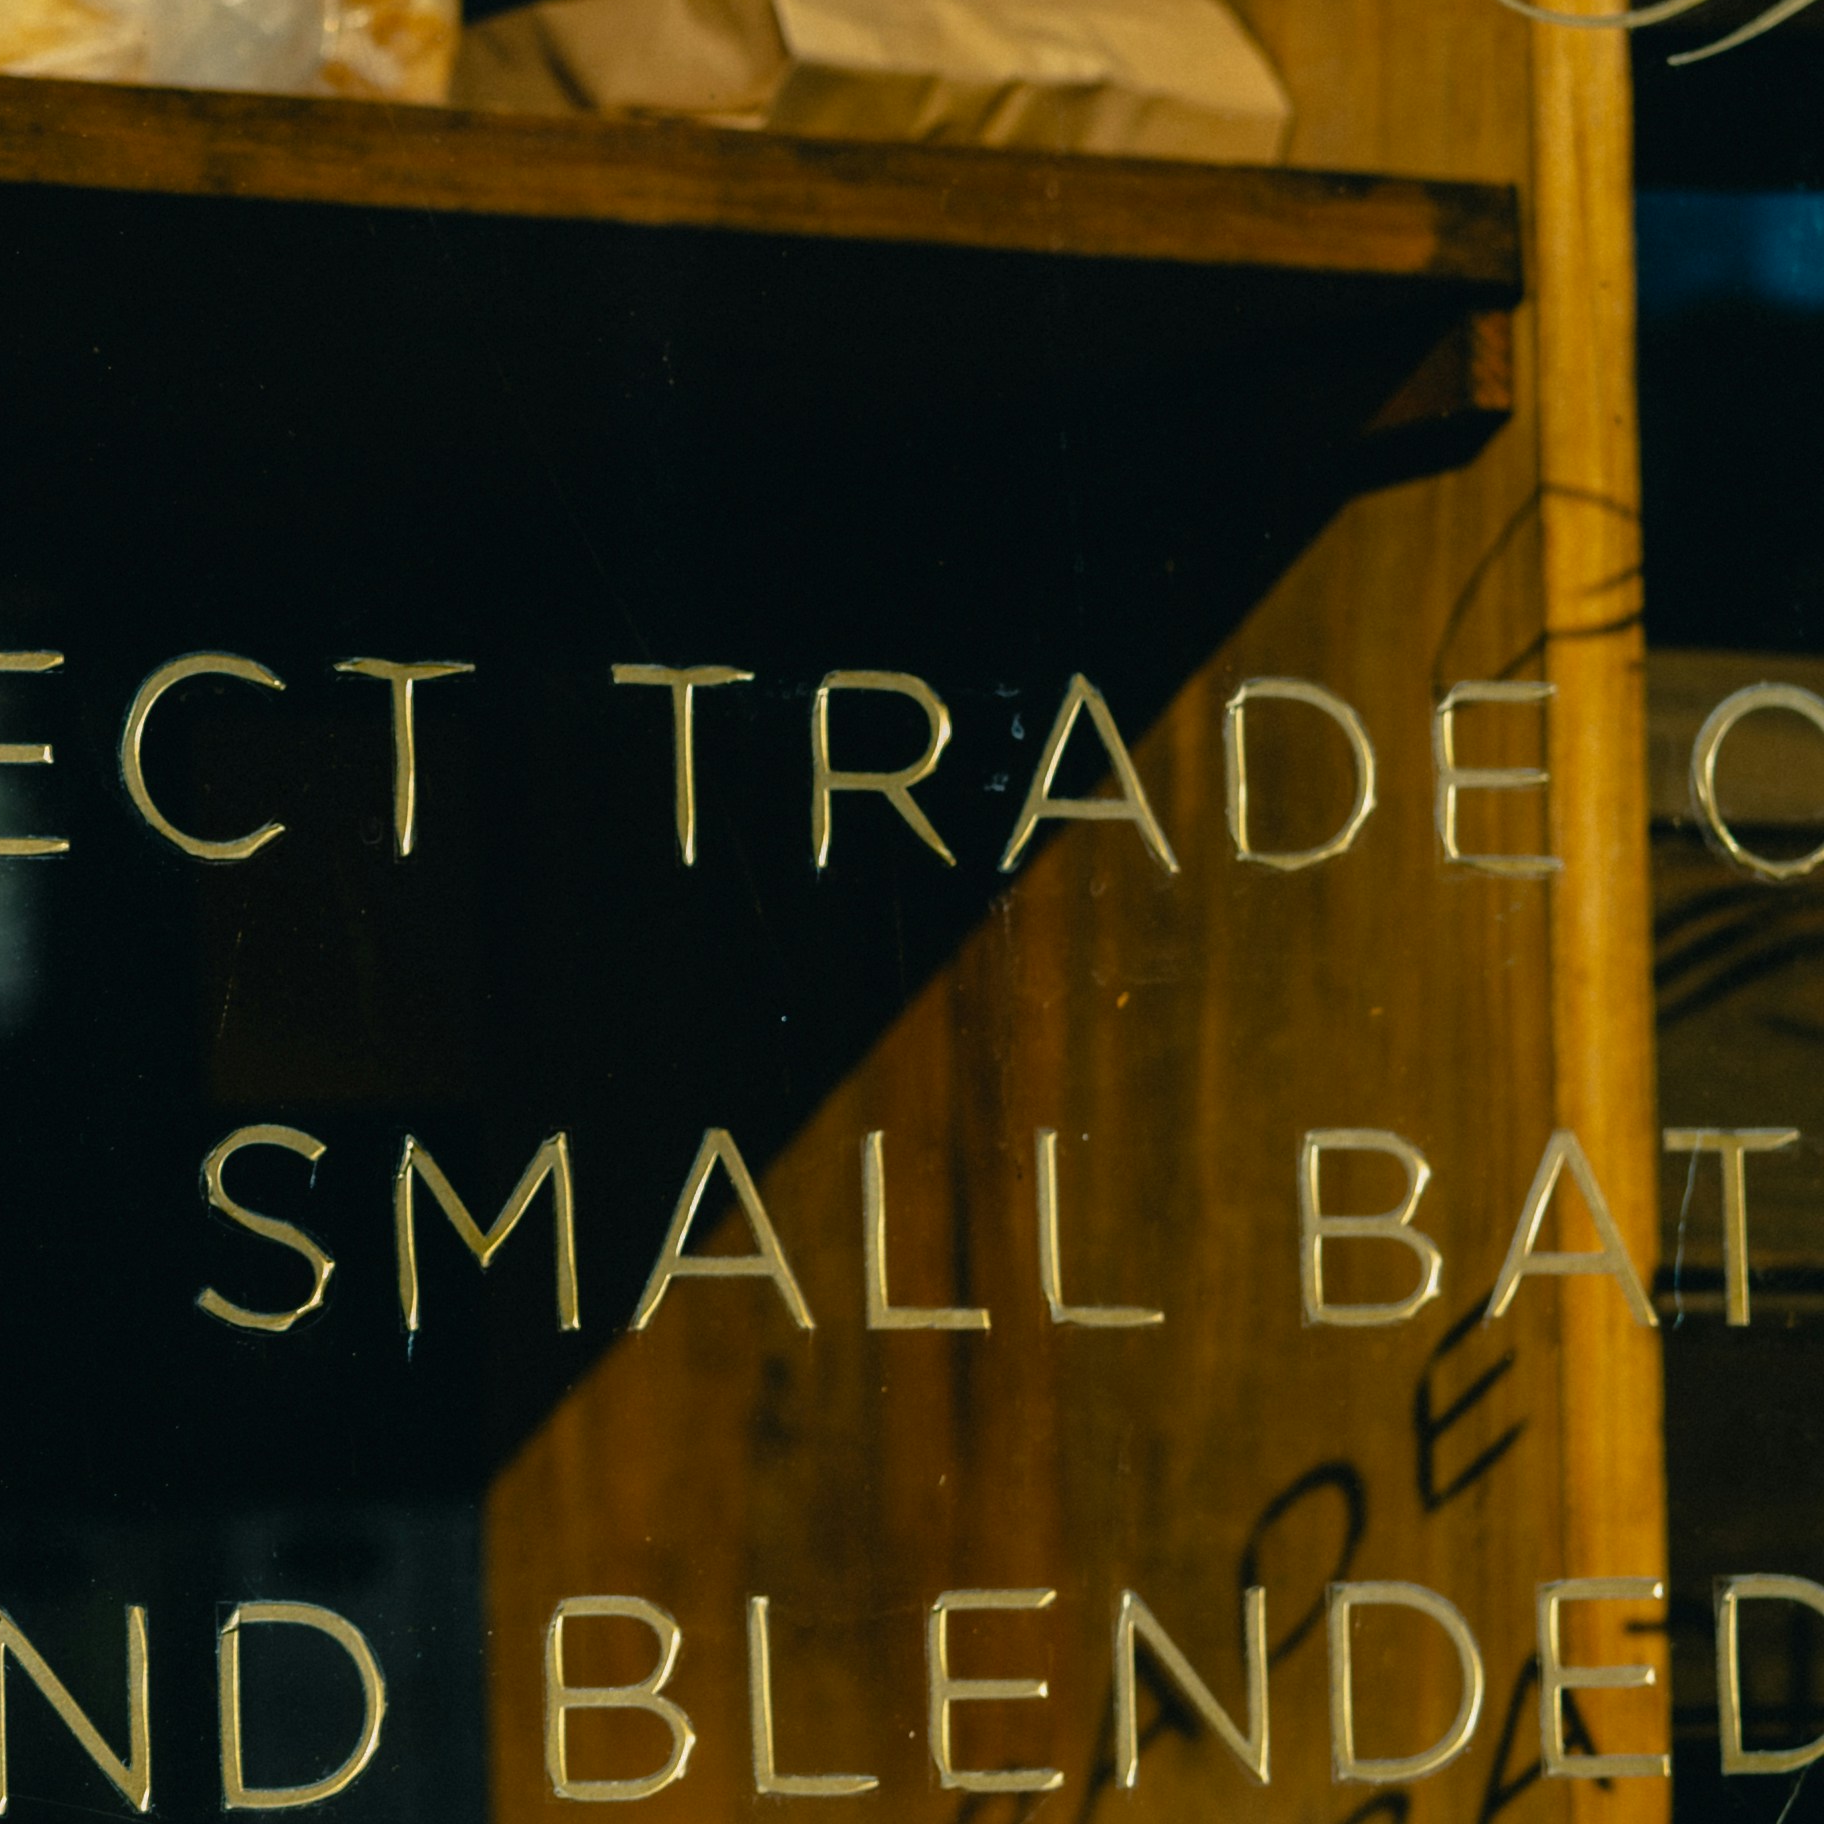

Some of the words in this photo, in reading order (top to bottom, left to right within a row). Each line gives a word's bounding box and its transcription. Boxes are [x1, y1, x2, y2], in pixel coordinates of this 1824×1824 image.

[611, 662, 1565, 873] TRADE
[196, 1122, 1166, 1332] SMALL
[1298, 1127, 1802, 1329] BAT
[543, 1573, 1824, 1804] BLENDED
